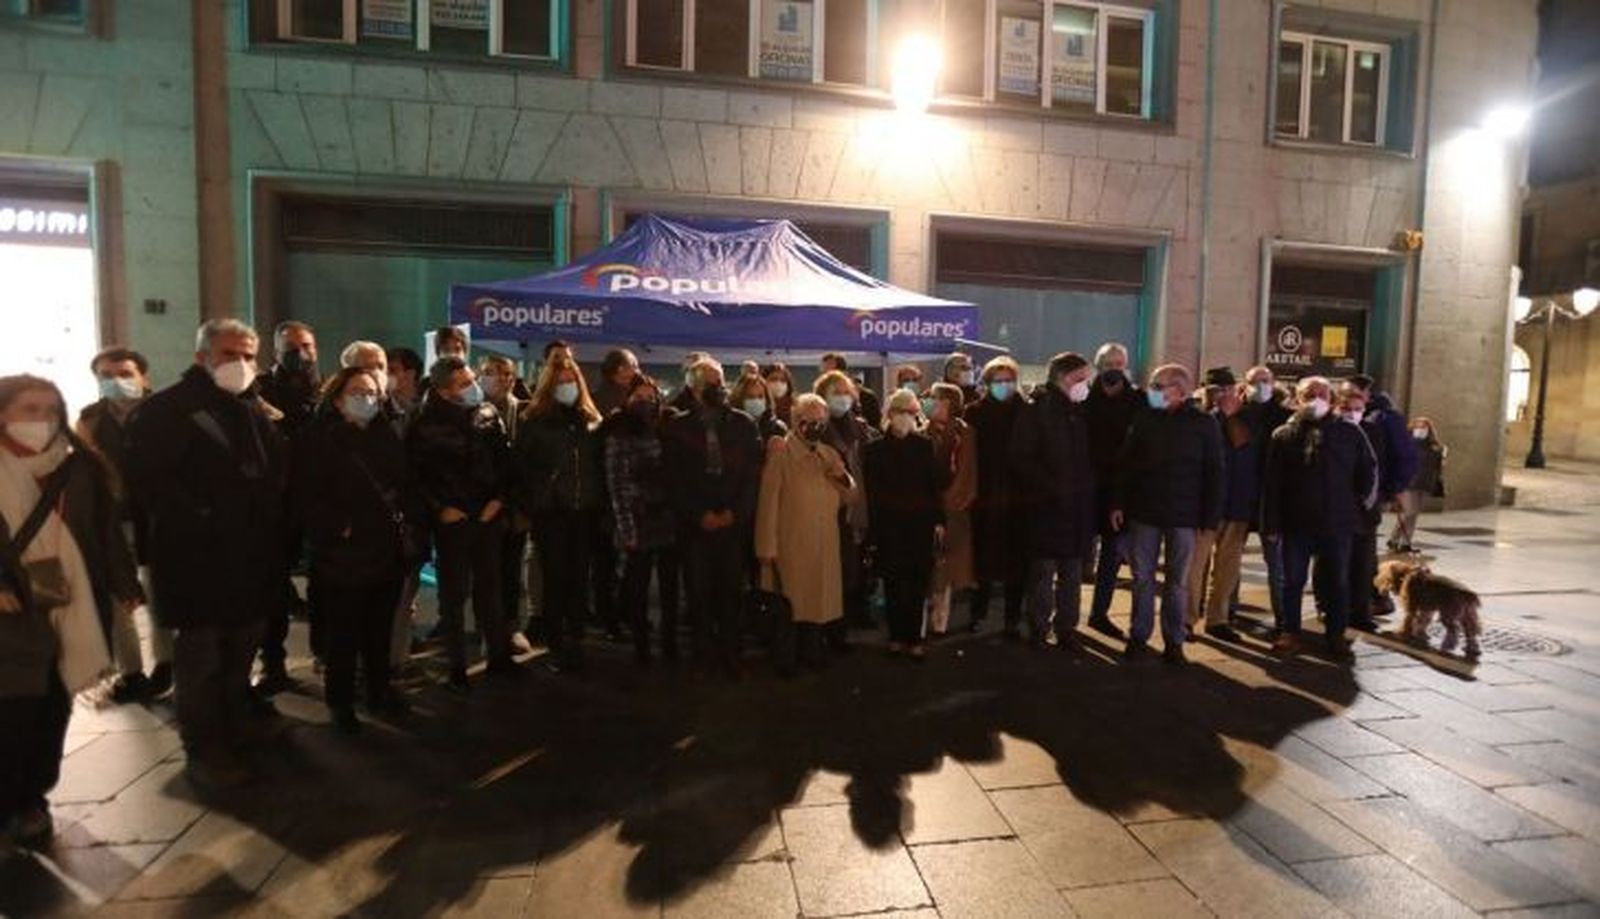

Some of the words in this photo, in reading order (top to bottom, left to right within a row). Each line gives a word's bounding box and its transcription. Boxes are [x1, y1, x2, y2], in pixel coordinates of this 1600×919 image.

[609, 273, 740, 295] popul
[483, 303, 604, 327] populares
[860, 316, 966, 341] populares
